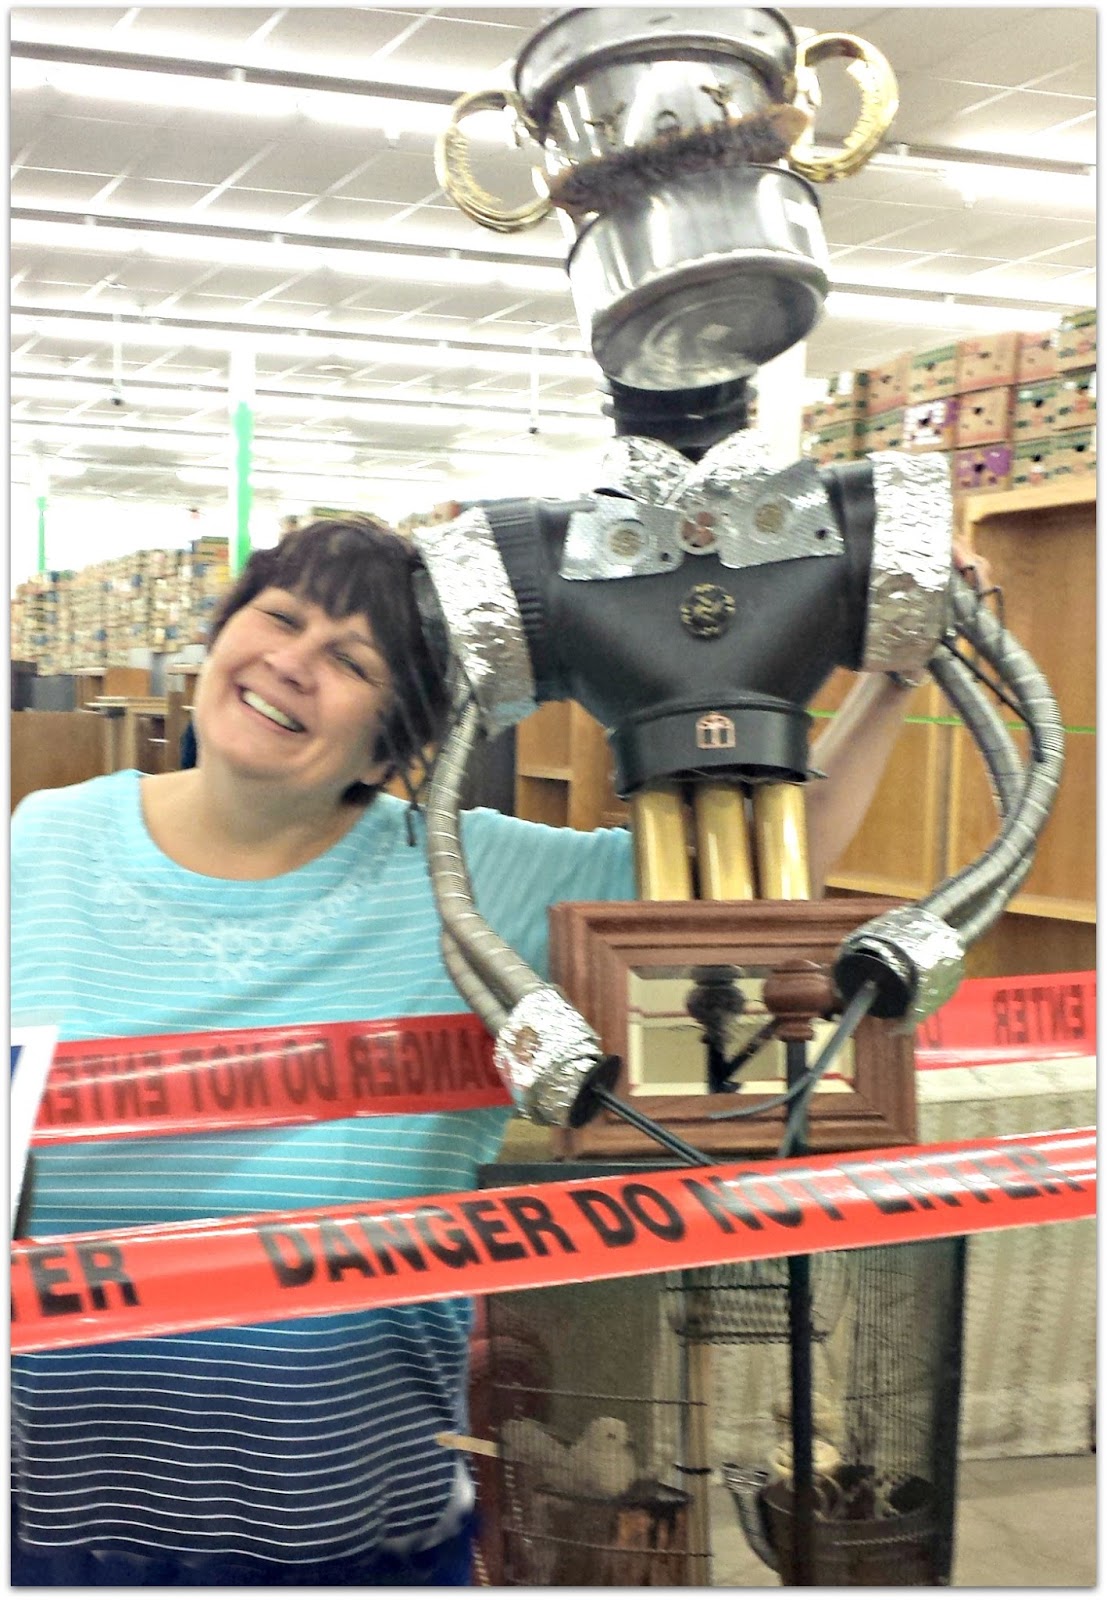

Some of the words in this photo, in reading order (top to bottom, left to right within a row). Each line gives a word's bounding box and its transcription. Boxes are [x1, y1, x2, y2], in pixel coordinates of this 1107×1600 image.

[257, 1194, 577, 1288] DANGER
[568, 1183, 686, 1247] DO
[682, 1165, 845, 1234] NOT
[834, 1144, 1087, 1215] ENTER
[11, 1240, 141, 1322] ER
